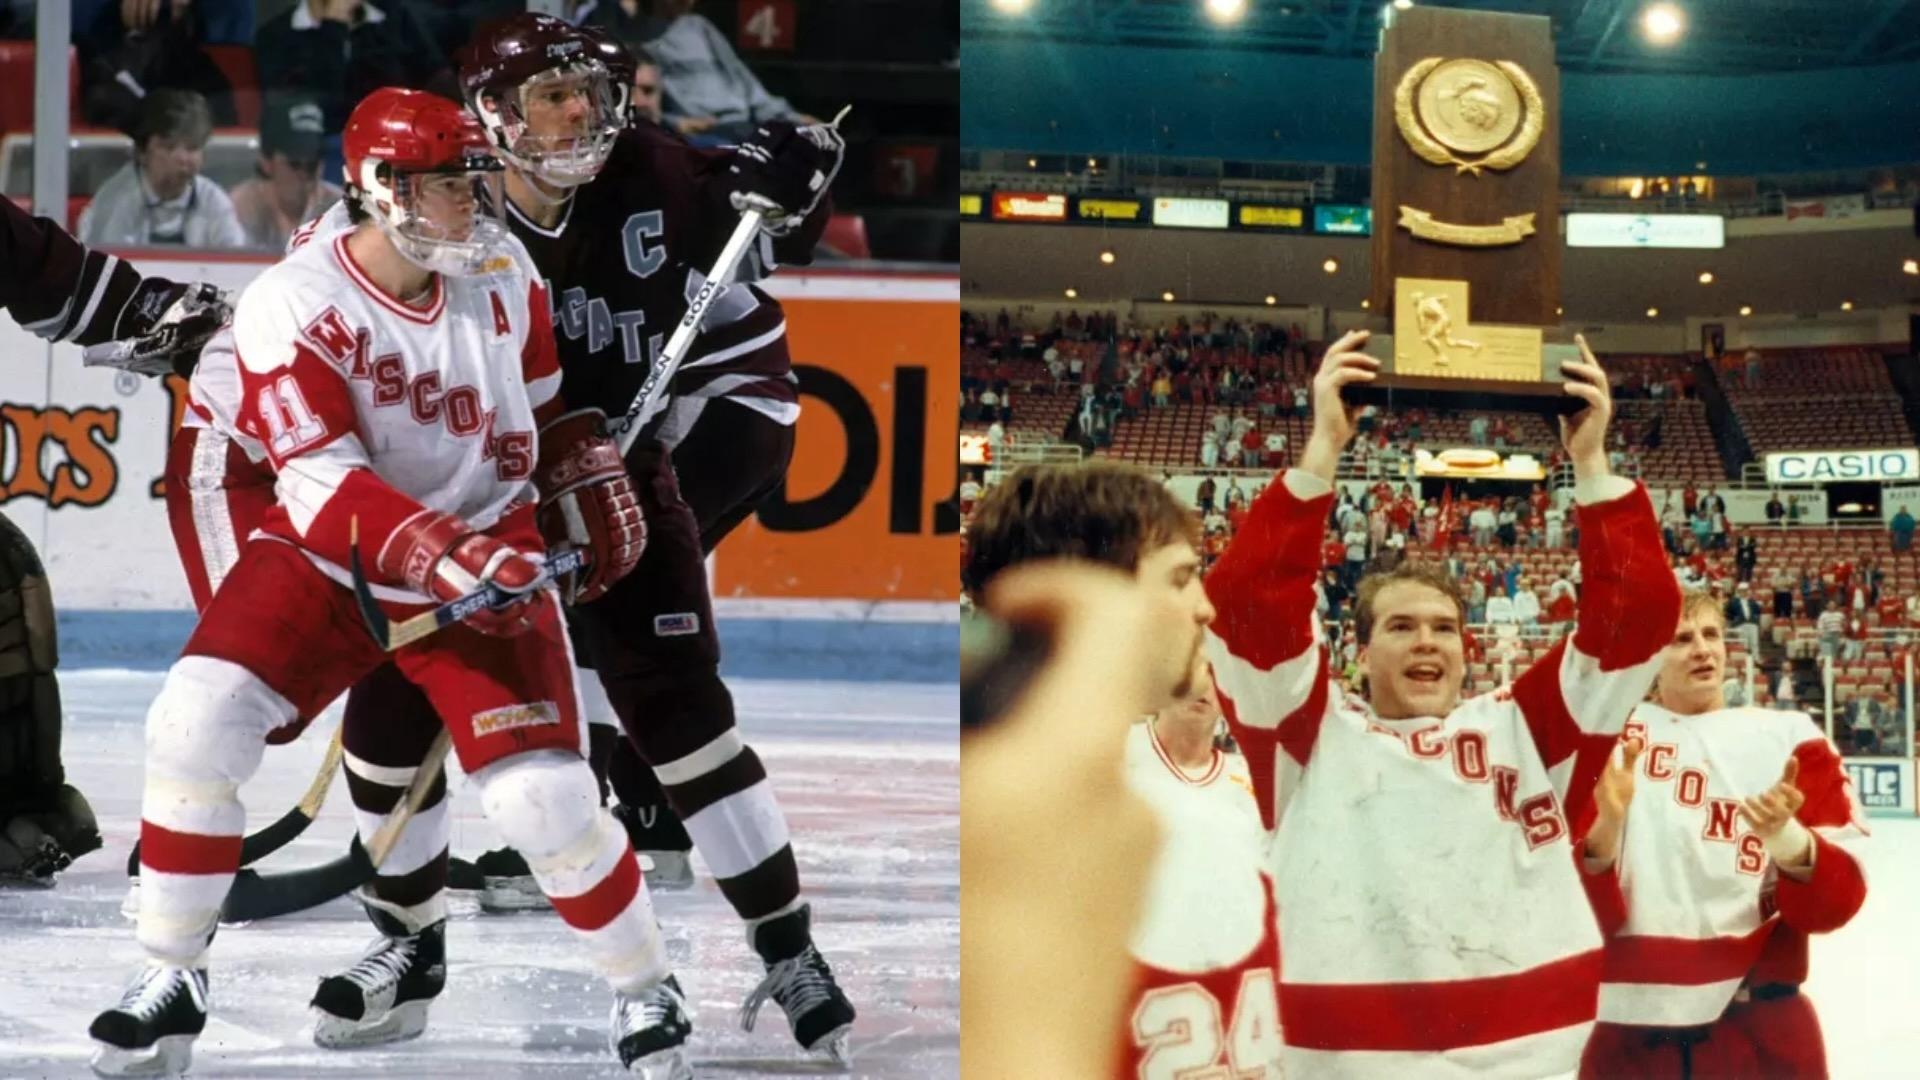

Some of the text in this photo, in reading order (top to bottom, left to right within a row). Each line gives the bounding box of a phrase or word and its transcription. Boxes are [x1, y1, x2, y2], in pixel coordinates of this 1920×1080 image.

[746, 5, 781, 47] 4
[621, 209, 668, 279] C
[490, 289, 512, 337] A
[258, 373, 329, 459] 11
[0, 403, 120, 509] rs
[1779, 453, 1907, 479] CASIO
[1132, 966, 1285, 1080] 24
